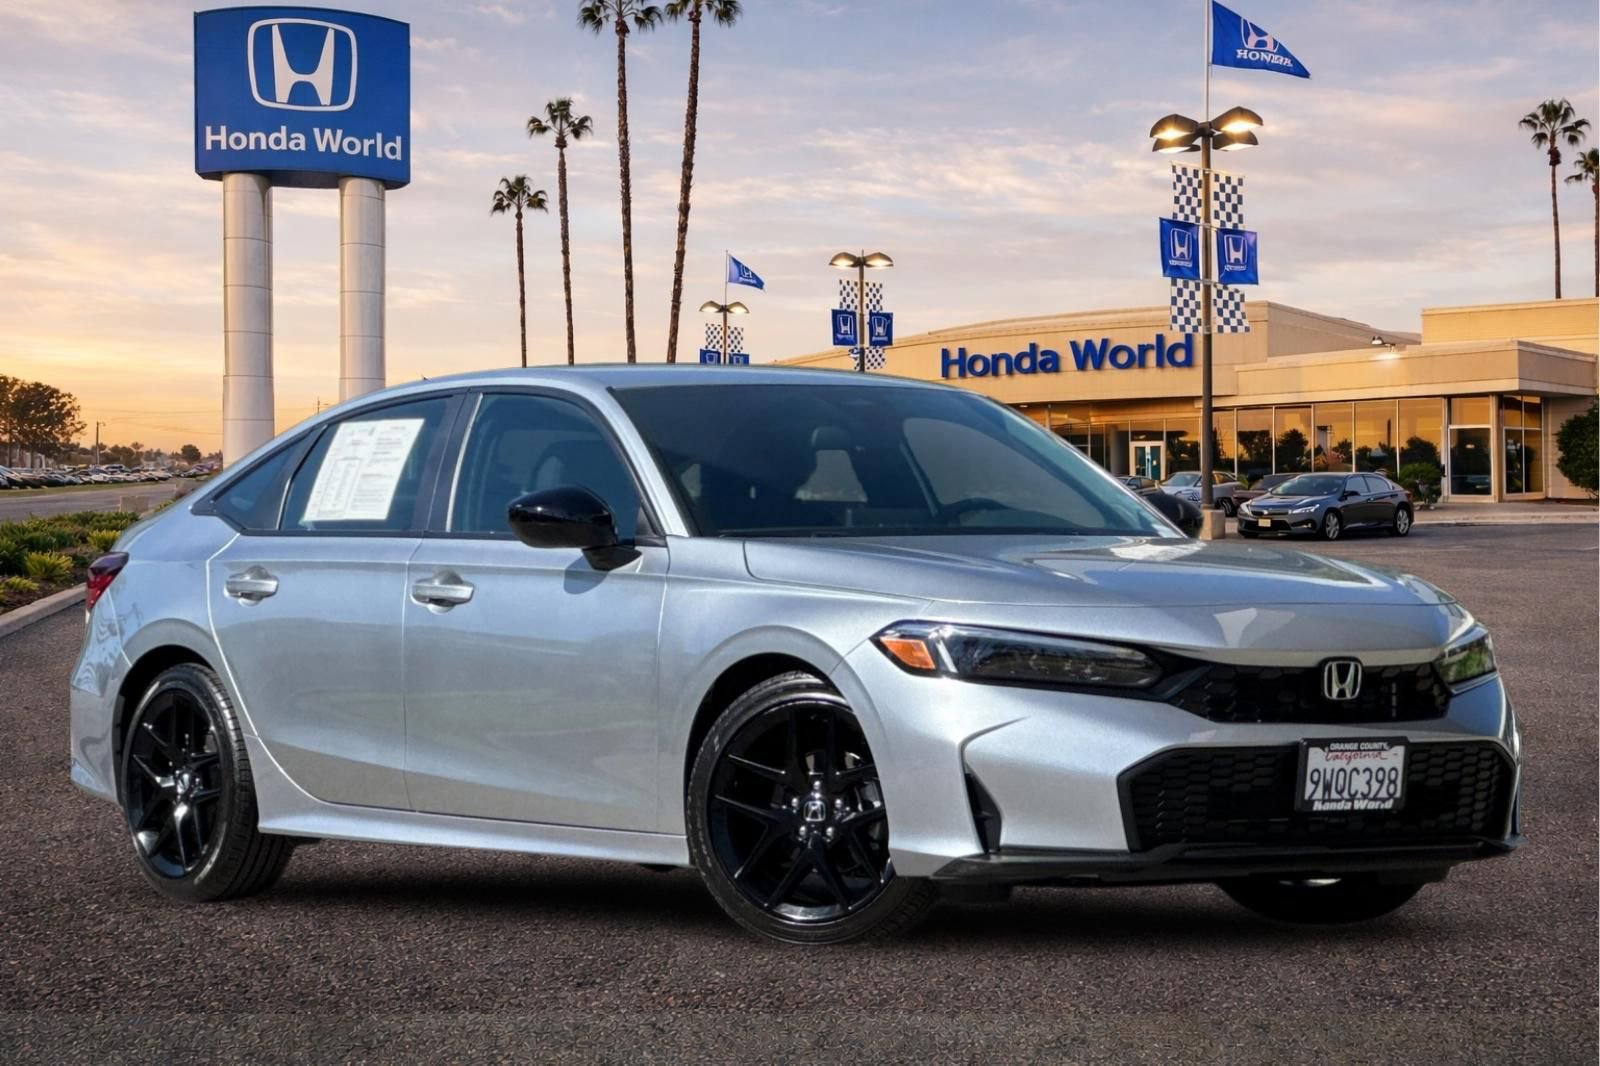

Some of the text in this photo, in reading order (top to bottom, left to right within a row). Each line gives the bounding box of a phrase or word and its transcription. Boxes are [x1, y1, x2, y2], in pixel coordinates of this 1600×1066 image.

[205, 125, 402, 161] Honda World
[941, 333, 1194, 378] Honda World
[1330, 742, 1359, 750] ORANGE
[1308, 766, 1399, 801] 9WQC398
